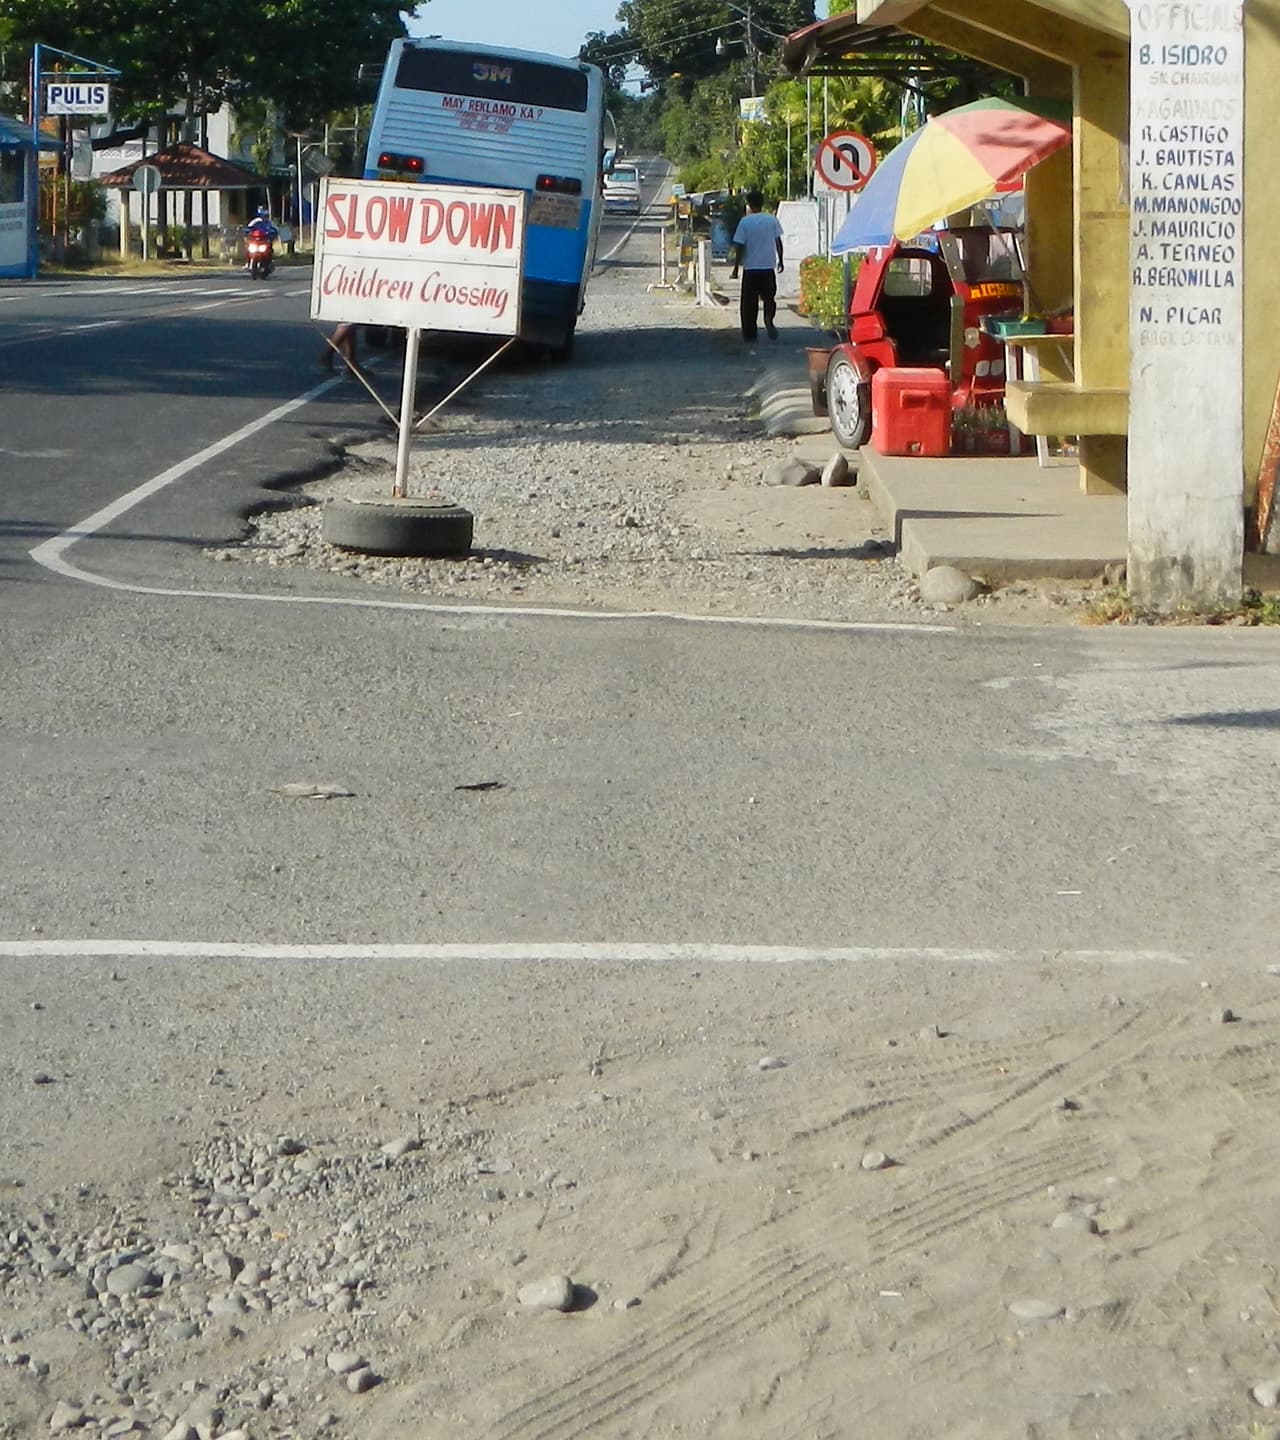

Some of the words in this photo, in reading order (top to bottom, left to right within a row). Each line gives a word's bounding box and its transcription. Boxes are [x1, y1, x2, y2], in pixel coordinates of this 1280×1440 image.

[1139, 44, 1156, 66] B.
[1161, 44, 1228, 66] ISIDRO
[51, 86, 104, 105] PULIS
[441, 96, 466, 110] MAY
[468, 99, 517, 119] REKLAMO
[1155, 149, 1235, 167] BAUTISTA
[1141, 173, 1157, 190] K.
[1162, 173, 1235, 191] CANLAS
[325, 193, 414, 244] SLOW
[419, 198, 516, 254] DOWN
[1136, 244, 1154, 261] A.
[1159, 244, 1235, 263] TERNEO
[322, 264, 414, 302] Children
[420, 271, 509, 319] Crossing
[1139, 307, 1158, 325] N.
[1166, 307, 1222, 325] PICAR
